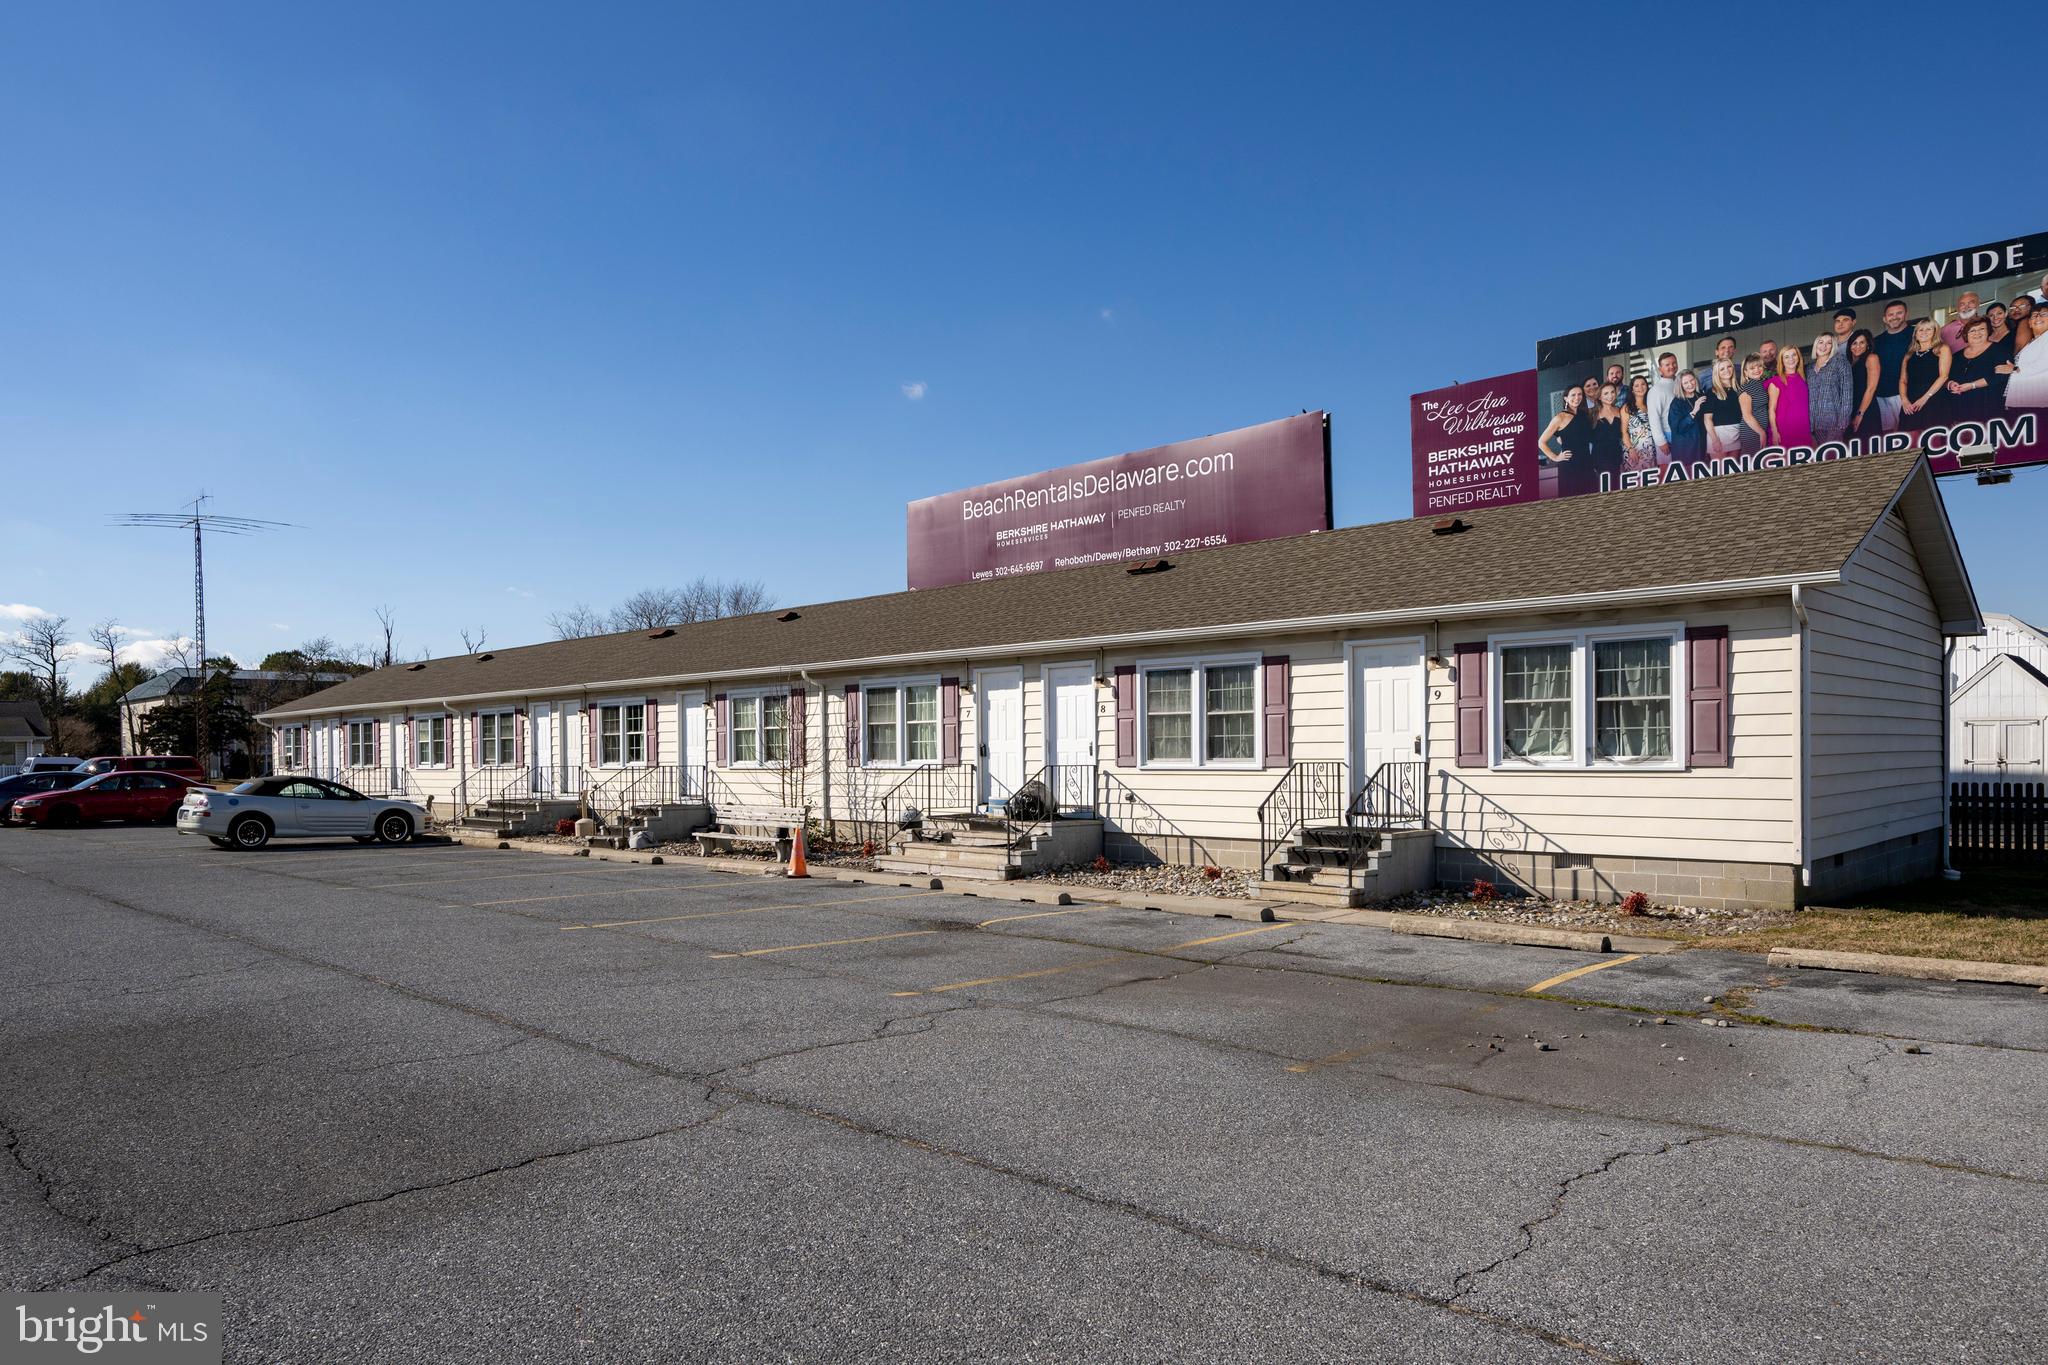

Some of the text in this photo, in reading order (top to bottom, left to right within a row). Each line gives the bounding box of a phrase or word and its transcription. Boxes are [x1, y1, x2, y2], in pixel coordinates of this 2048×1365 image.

[1607, 243, 2024, 350] #1 BHHS NATIONWIDE
[1421, 391, 1509, 421] The Lee Ann
[1443, 410, 1526, 435] Wilkinson
[1492, 424, 1524, 436] Group
[1428, 438, 1515, 463] BERKSHIRE
[1600, 413, 2037, 493] LEEANNGROUPCOM
[1428, 452, 1515, 477] HATHAWAY
[963, 451, 1235, 520] BeachRentalsDelaware.com
[1428, 468, 1515, 488] HOMESERVICES
[1429, 484, 1522, 509] PENFED REALTY
[996, 499, 1186, 541] BERKSHIRE HATHAWAY PENFED REALTY
[996, 534, 1048, 548] HOMESERVICES
[972, 534, 1227, 580] Lewes 302-645-6697 Rehoboth/Dewey/Bethany 302-227-6554
[1434, 690, 1442, 700] 9
[966, 710, 971, 718] 7
[1100, 705, 1106, 714] 8
